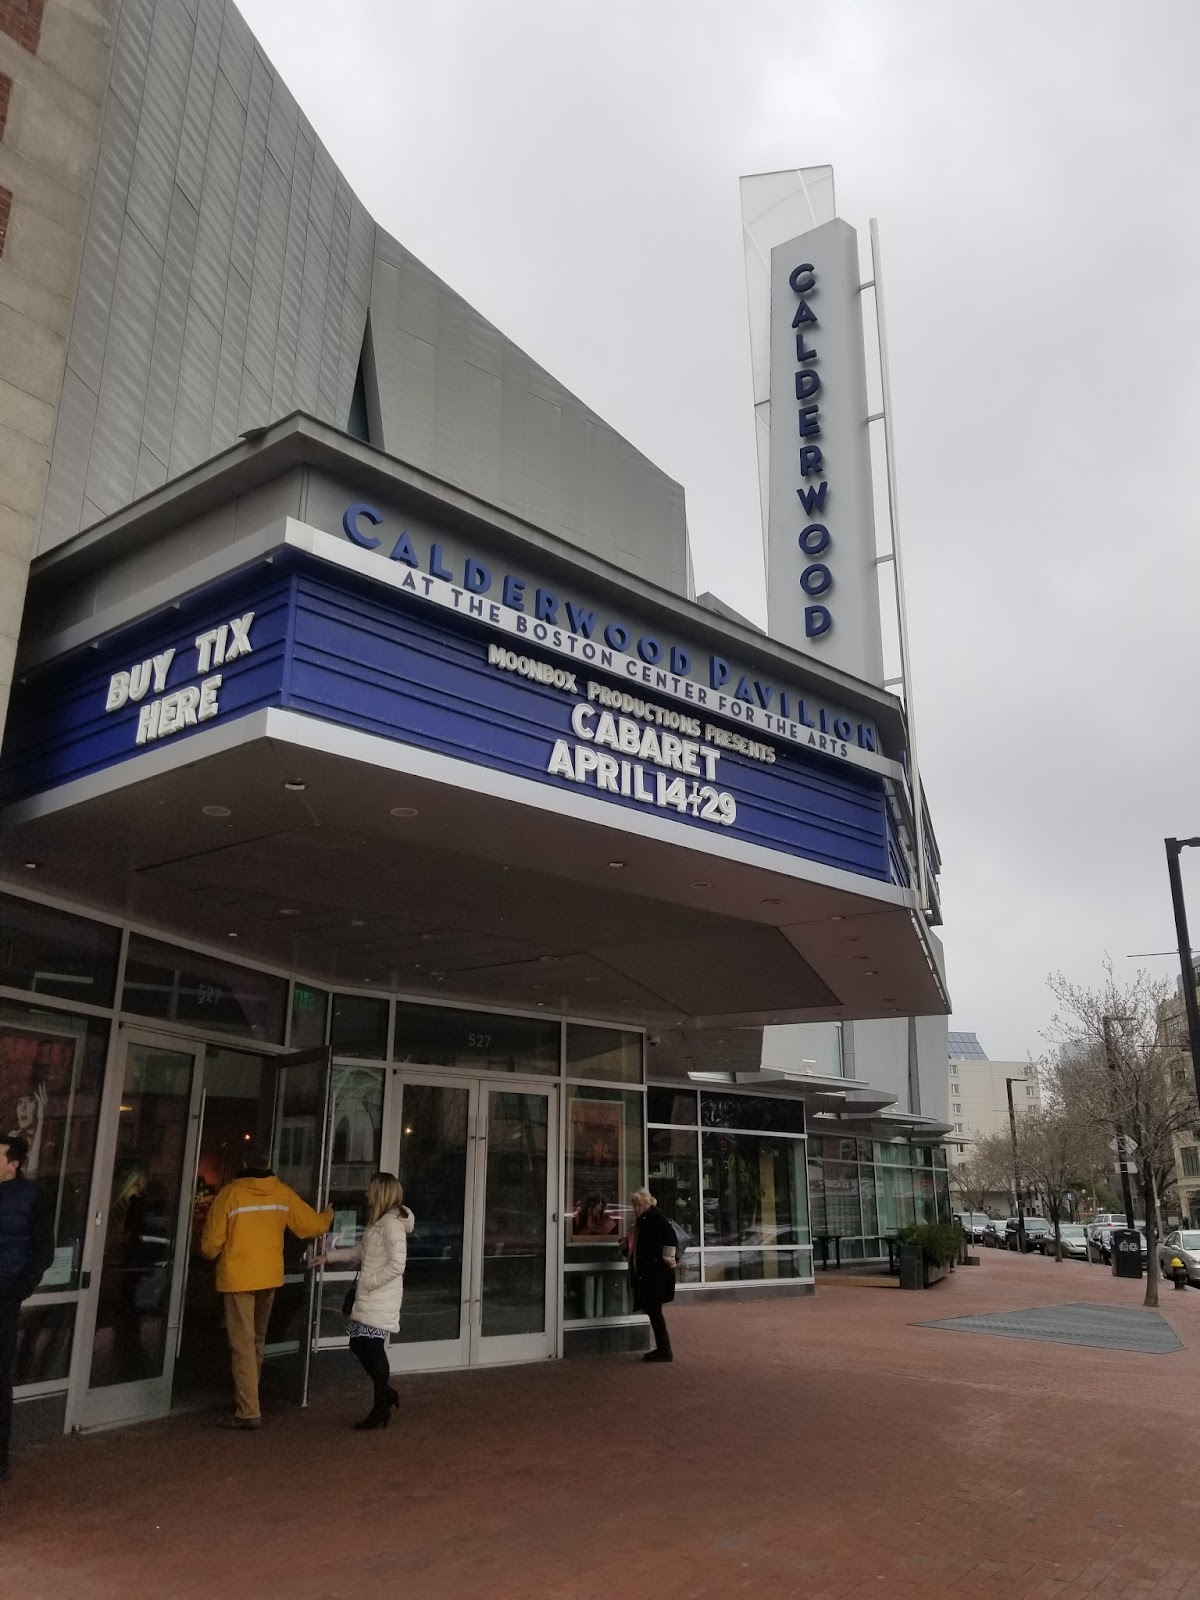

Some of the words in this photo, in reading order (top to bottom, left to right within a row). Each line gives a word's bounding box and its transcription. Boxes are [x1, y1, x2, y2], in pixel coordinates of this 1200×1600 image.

[788, 263, 832, 638] CALDERWOOD
[105, 648, 176, 713] BUY
[195, 612, 256, 674] TIX
[342, 503, 692, 677] CALDERWOOD
[709, 655, 876, 752] PAVILION
[402, 571, 434, 596] AT
[452, 589, 501, 624] THE
[517, 614, 613, 668] BOSTON
[626, 660, 707, 705] CENTER
[718, 699, 755, 723] FOR
[765, 714, 798, 739] THE
[808, 732, 848, 758] ARTS
[135, 674, 223, 746] HERE
[488, 644, 578, 694] MOONBOX
[587, 680, 702, 738] PRODUCTIONS
[704, 723, 777, 764] PRESENTS
[571, 702, 721, 782] CABARET
[547, 739, 654, 803] APRIL
[468, 1033, 492, 1049] 527
